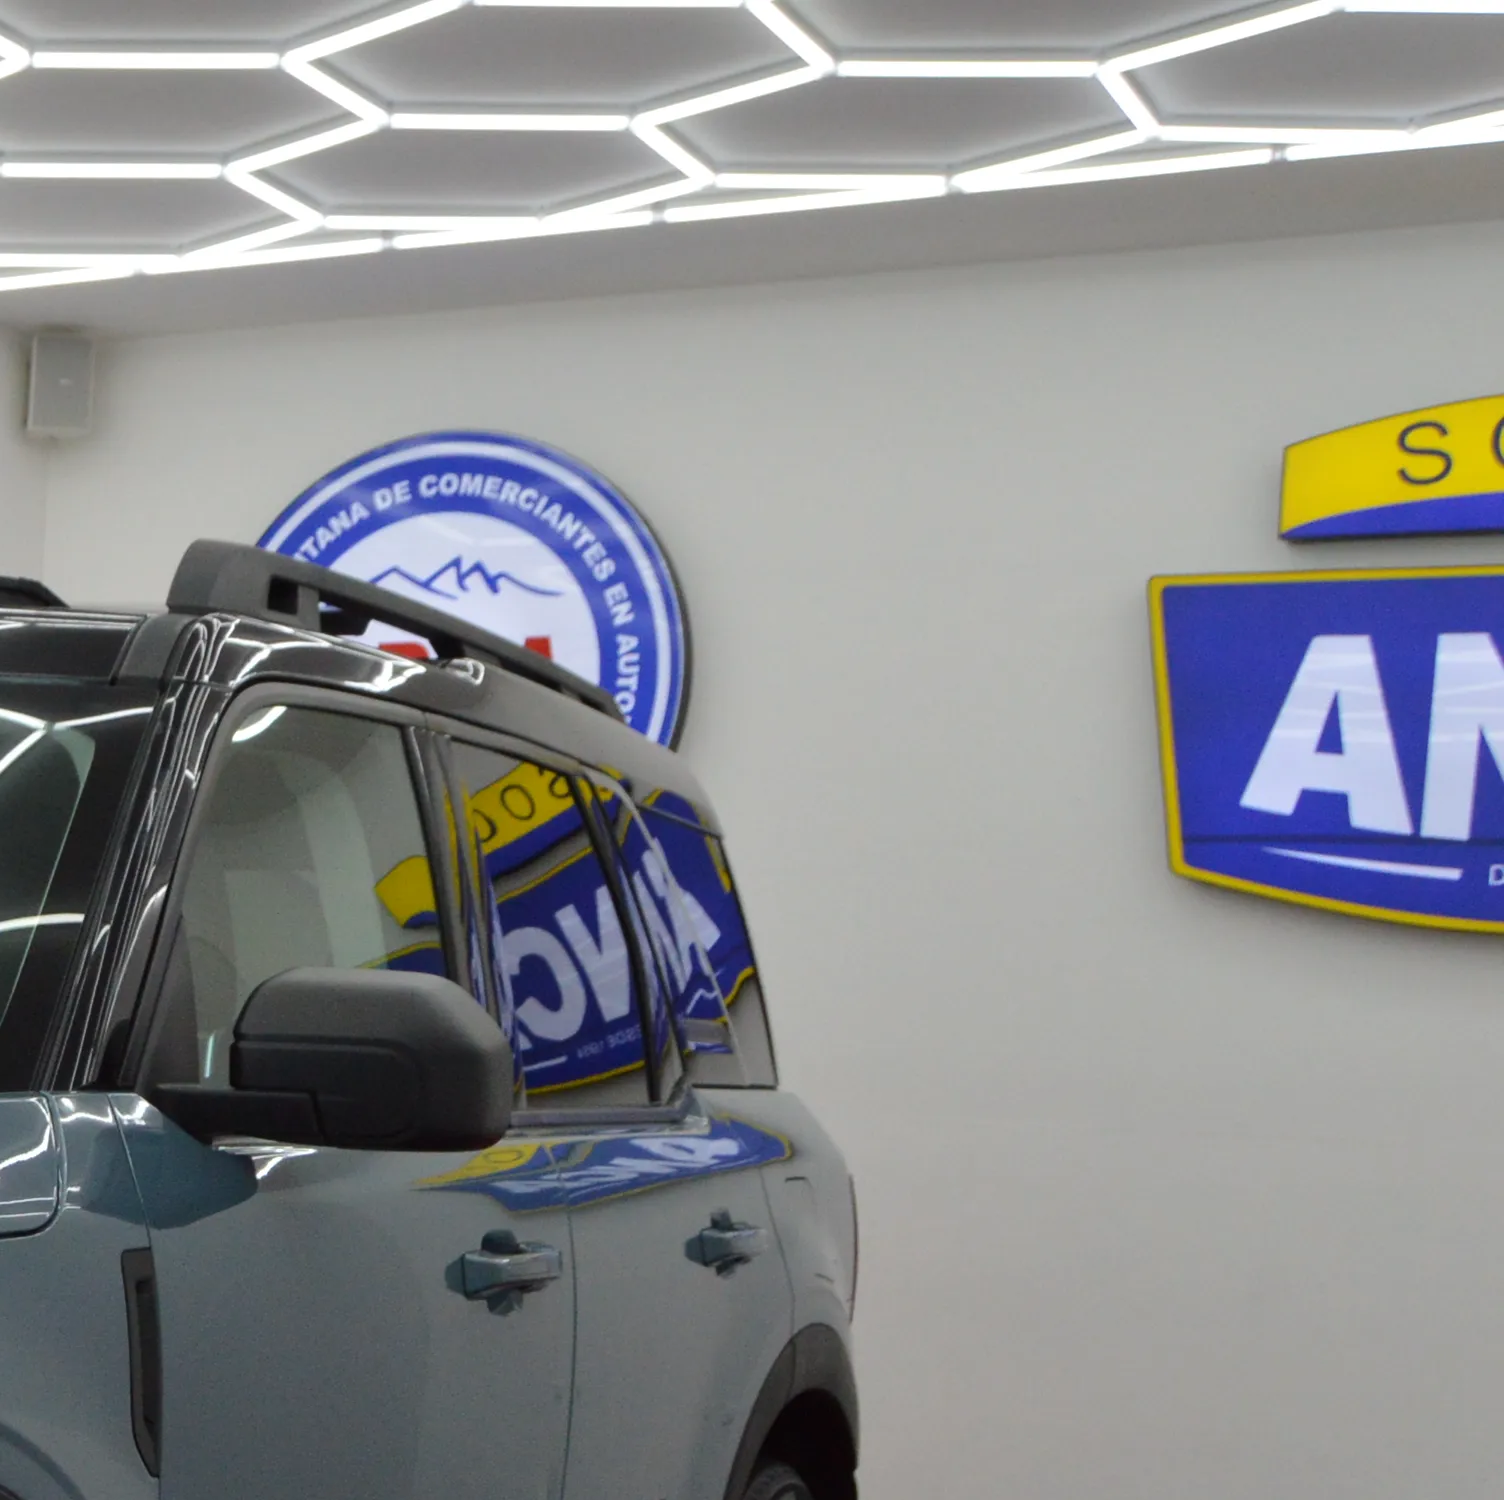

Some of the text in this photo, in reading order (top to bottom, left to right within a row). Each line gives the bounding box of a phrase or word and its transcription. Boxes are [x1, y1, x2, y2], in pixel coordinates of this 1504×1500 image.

[1397, 417, 1503, 486] S
[372, 479, 413, 512] DE
[418, 472, 616, 582] COMERCIANTES
[603, 581, 635, 627] EN
[614, 632, 640, 726] AUTO
